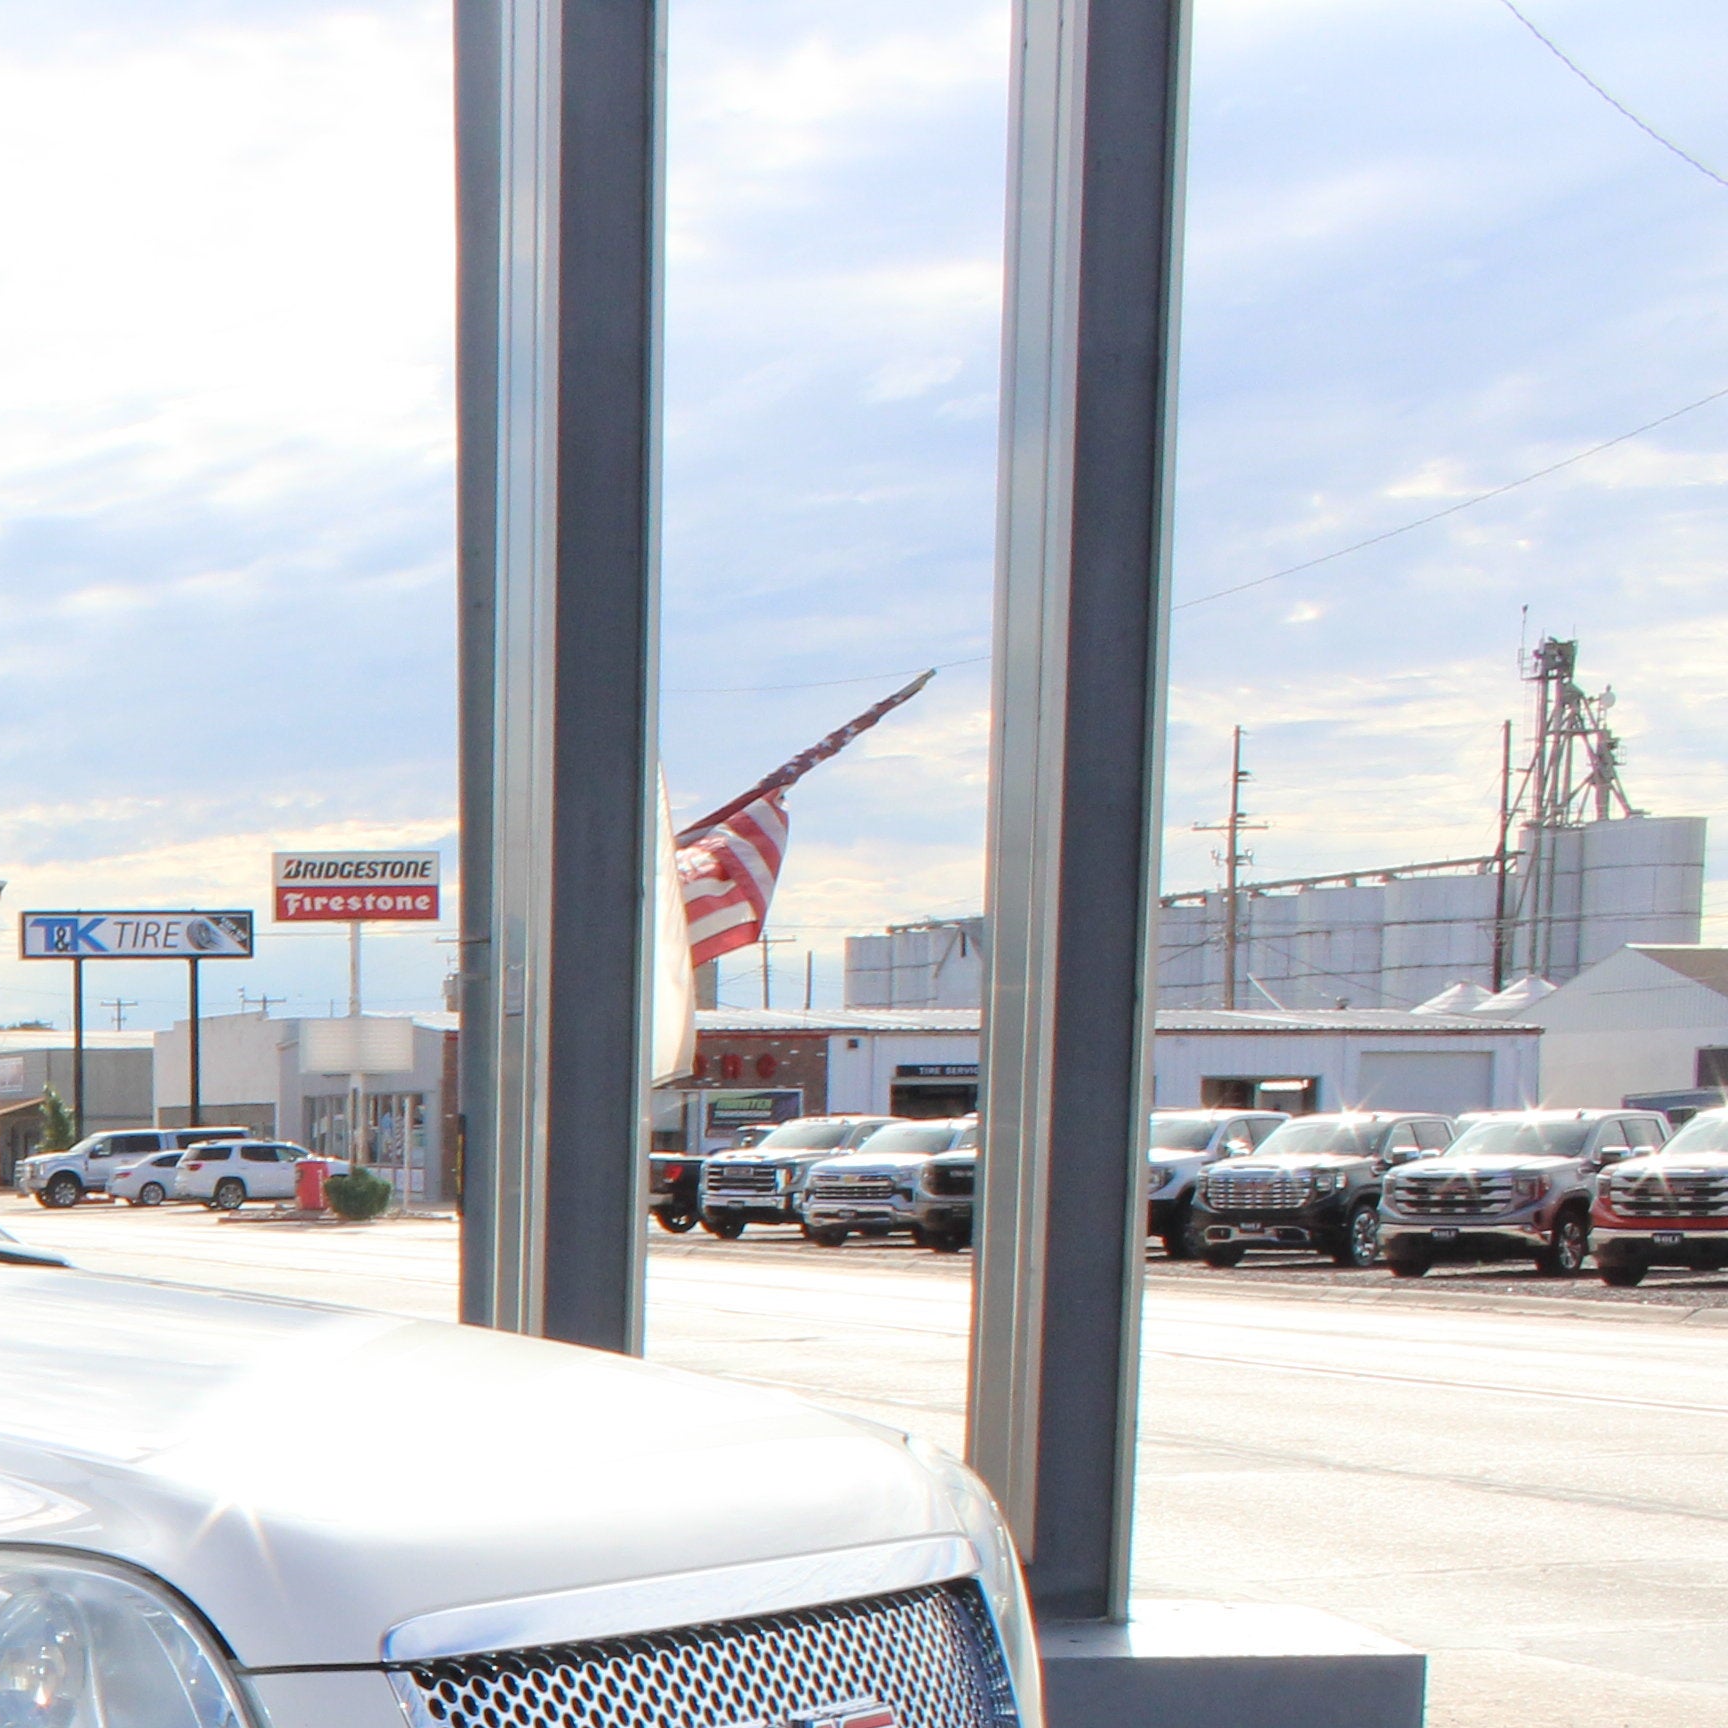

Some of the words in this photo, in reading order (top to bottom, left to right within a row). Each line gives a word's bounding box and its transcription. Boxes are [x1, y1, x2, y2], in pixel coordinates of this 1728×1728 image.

[283, 859, 433, 879] BRIDGESTONE
[283, 892, 432, 917] Firestone
[112, 920, 182, 949] TIRE
